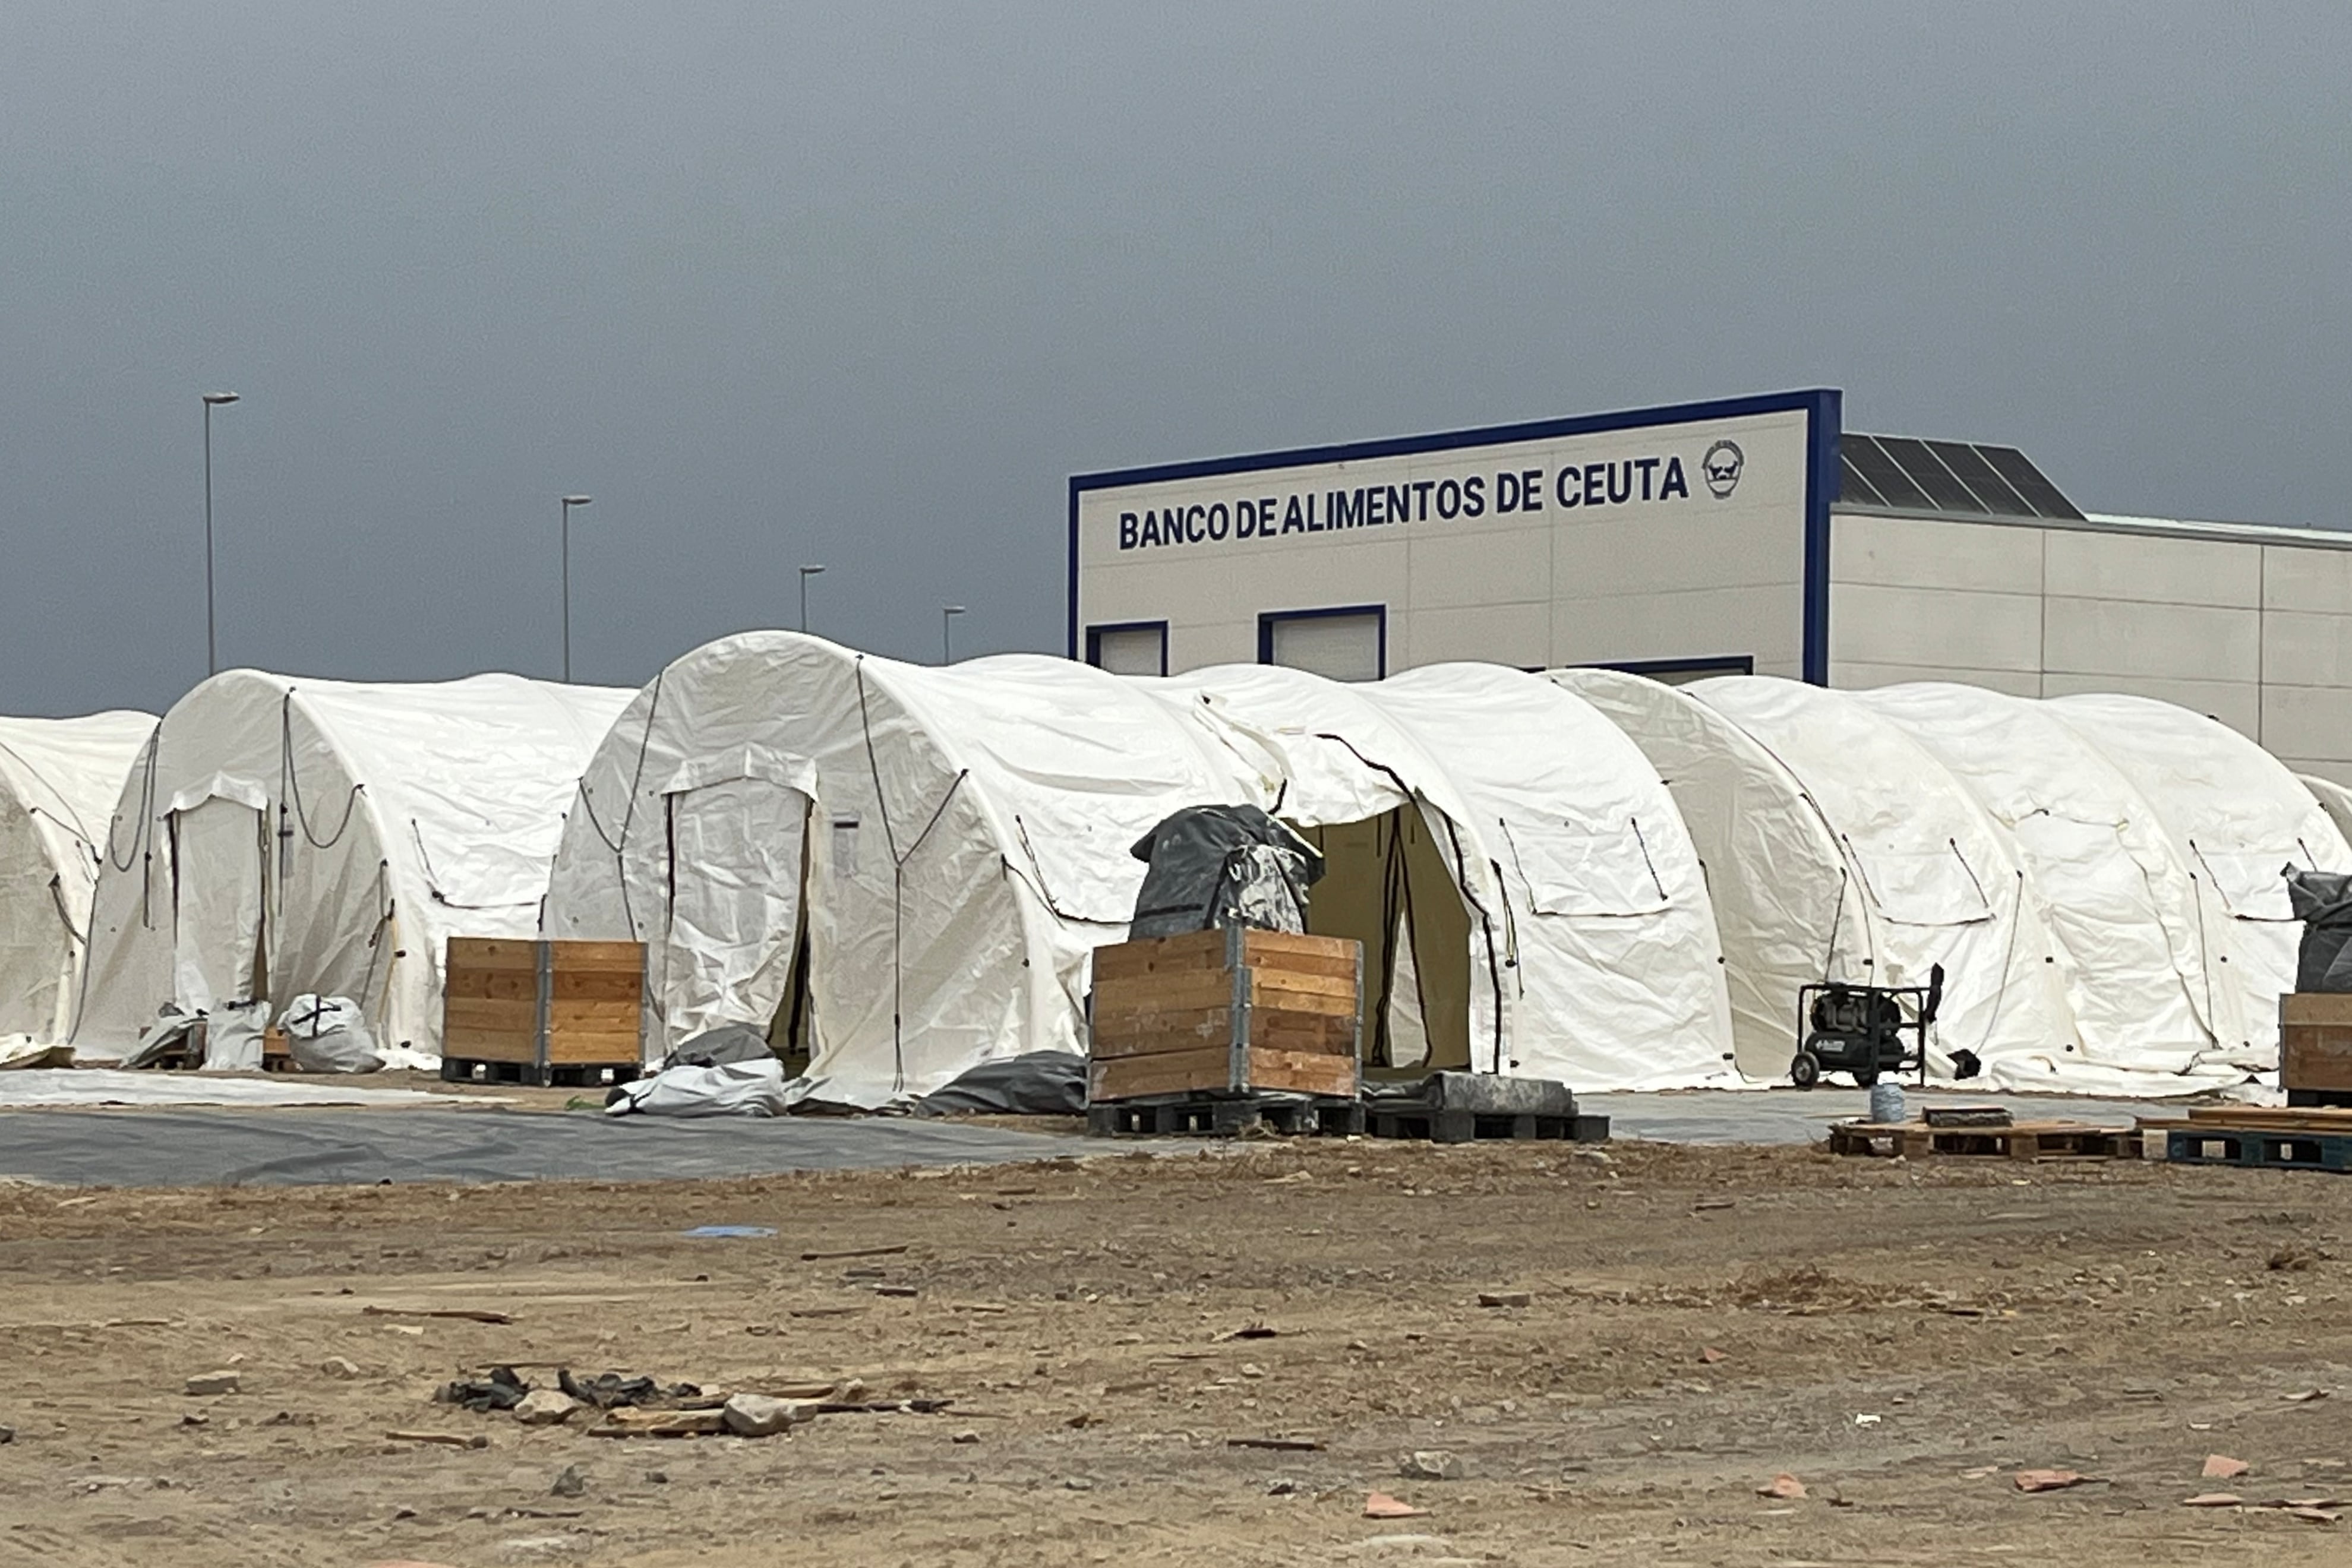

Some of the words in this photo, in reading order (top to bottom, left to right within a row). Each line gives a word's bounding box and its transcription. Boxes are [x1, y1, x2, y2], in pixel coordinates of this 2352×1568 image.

[1119, 503, 1230, 551] BANCO
[1236, 498, 1278, 539] DE
[1280, 476, 1486, 535] ALIMENTOS
[1496, 470, 1543, 514] DE
[1556, 457, 1690, 508] CEUTA
